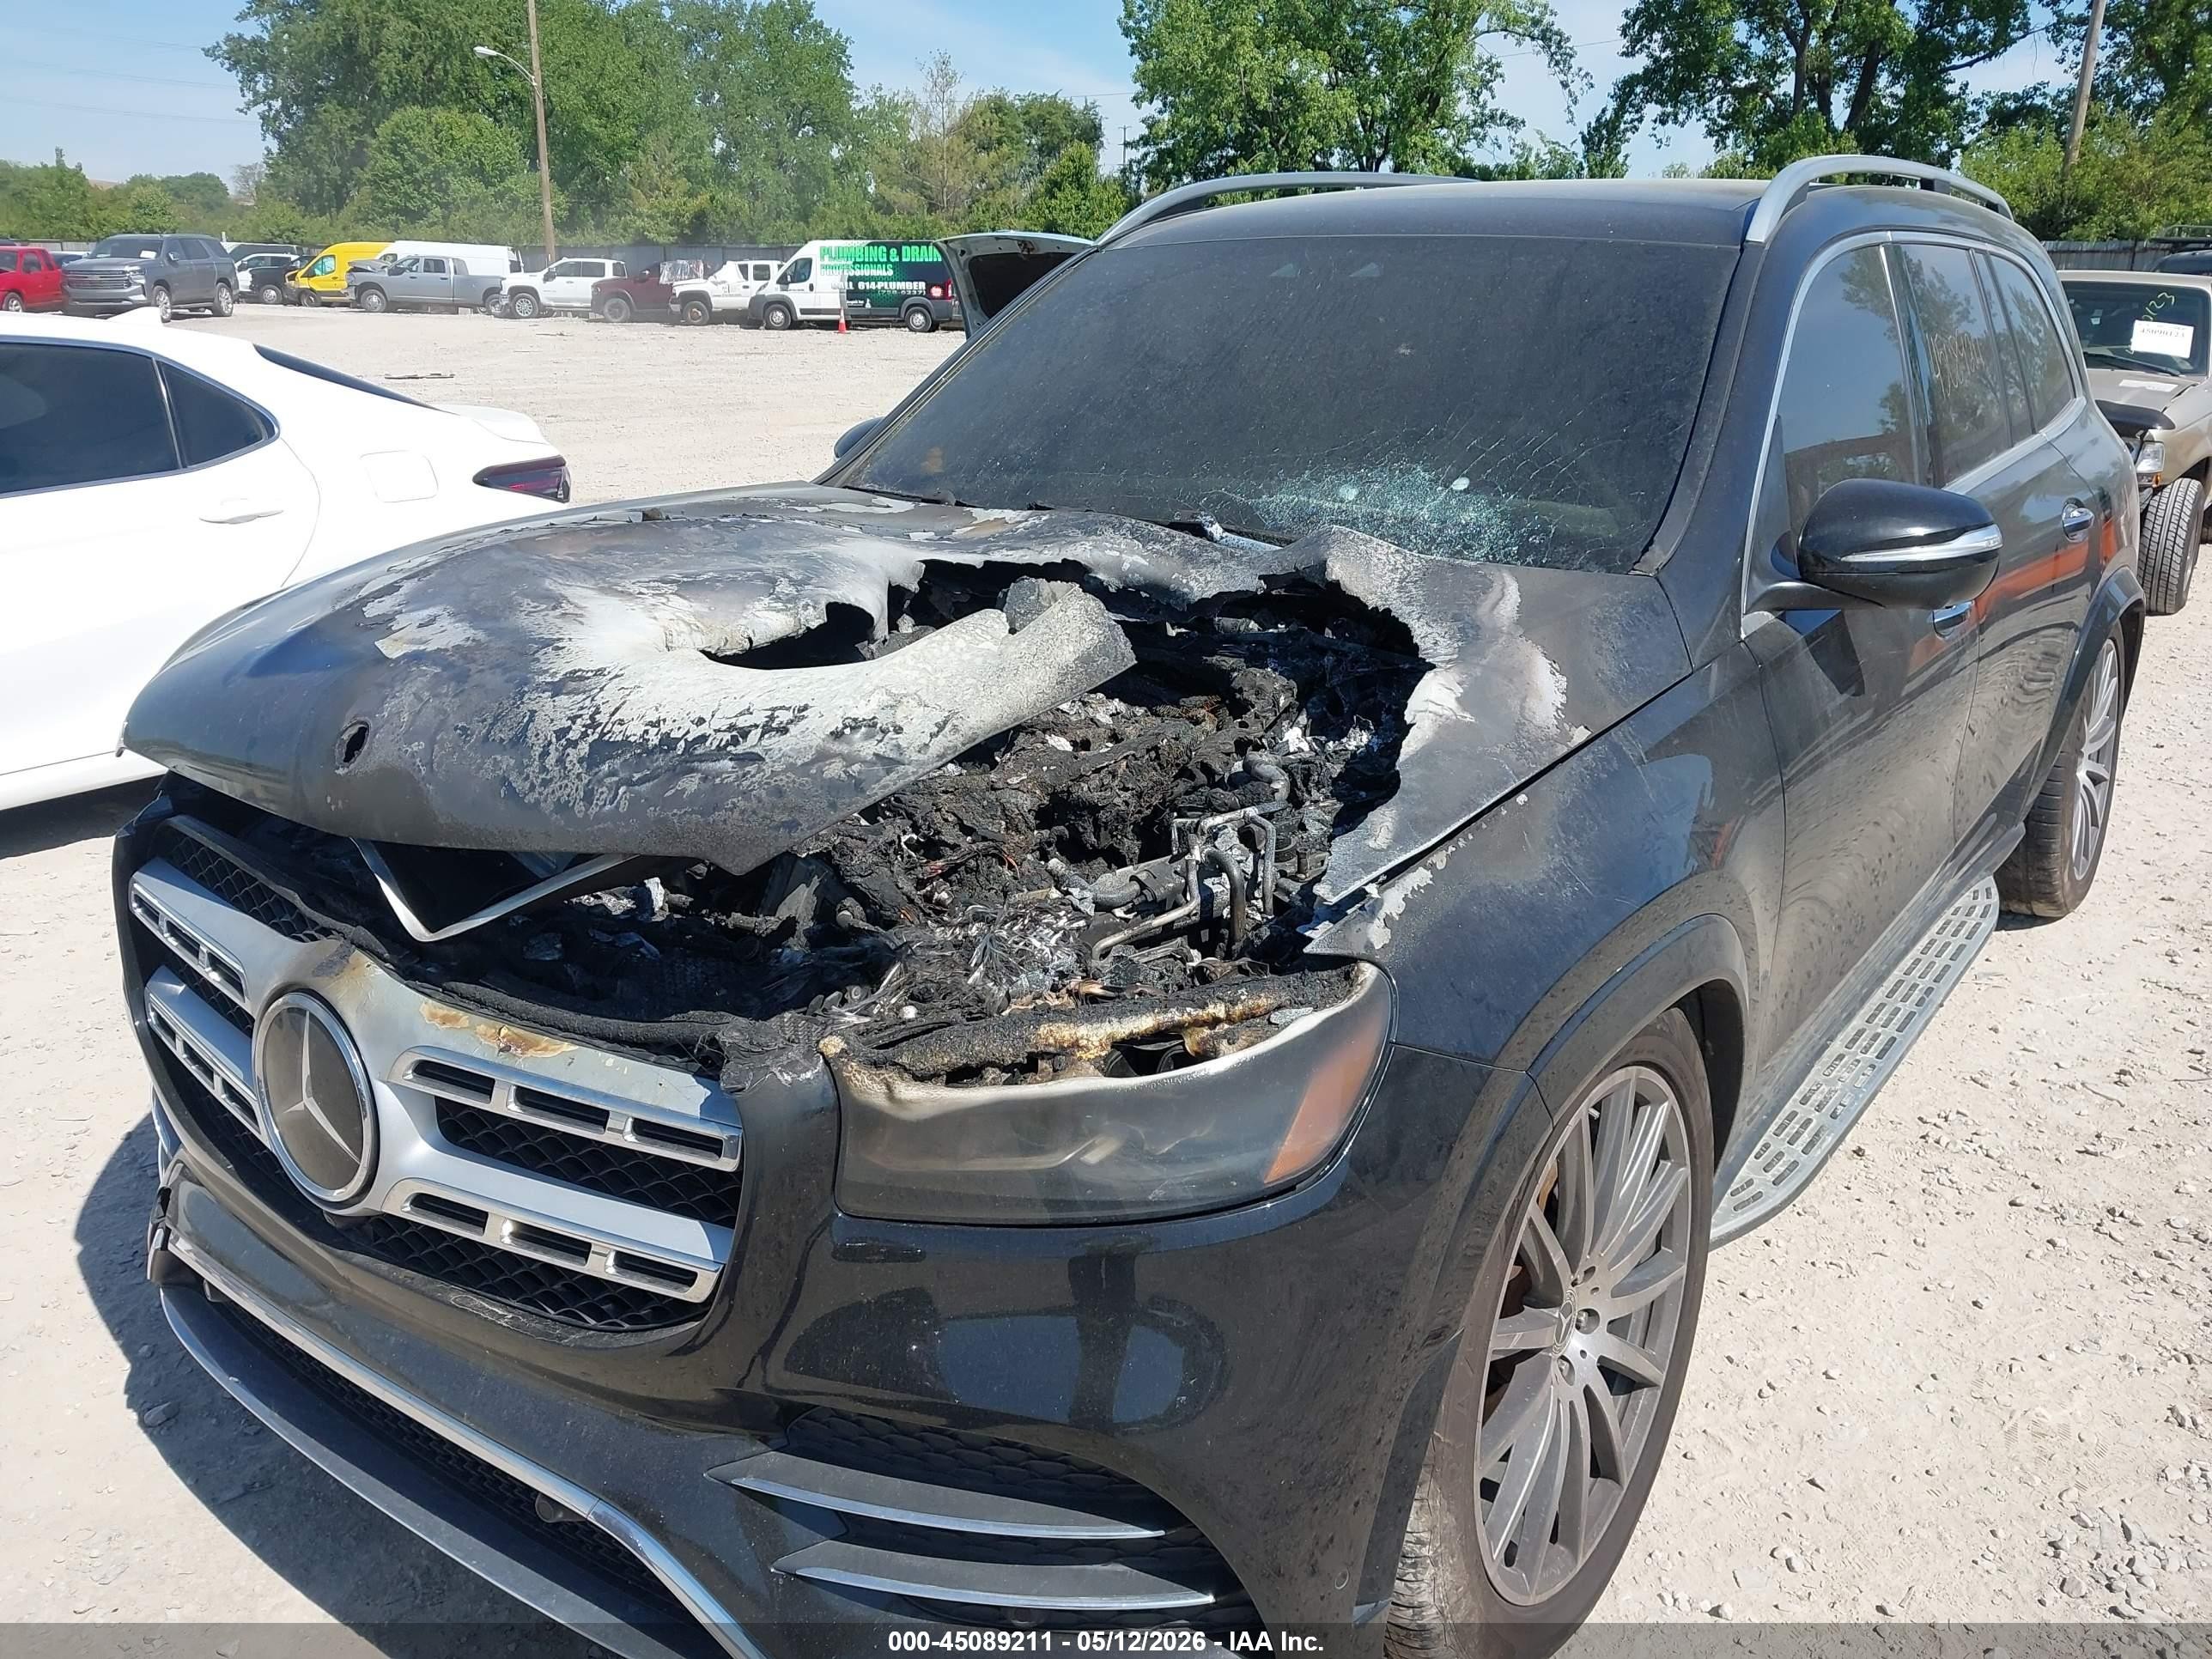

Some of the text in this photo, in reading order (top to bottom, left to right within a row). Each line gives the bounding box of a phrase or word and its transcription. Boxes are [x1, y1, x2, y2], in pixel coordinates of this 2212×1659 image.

[819, 246, 887, 262] PLUMBING
[890, 247, 899, 262] &
[820, 263, 894, 276] PROFESSIONALS
[831, 281, 927, 290] CALL 614-PLUMBER
